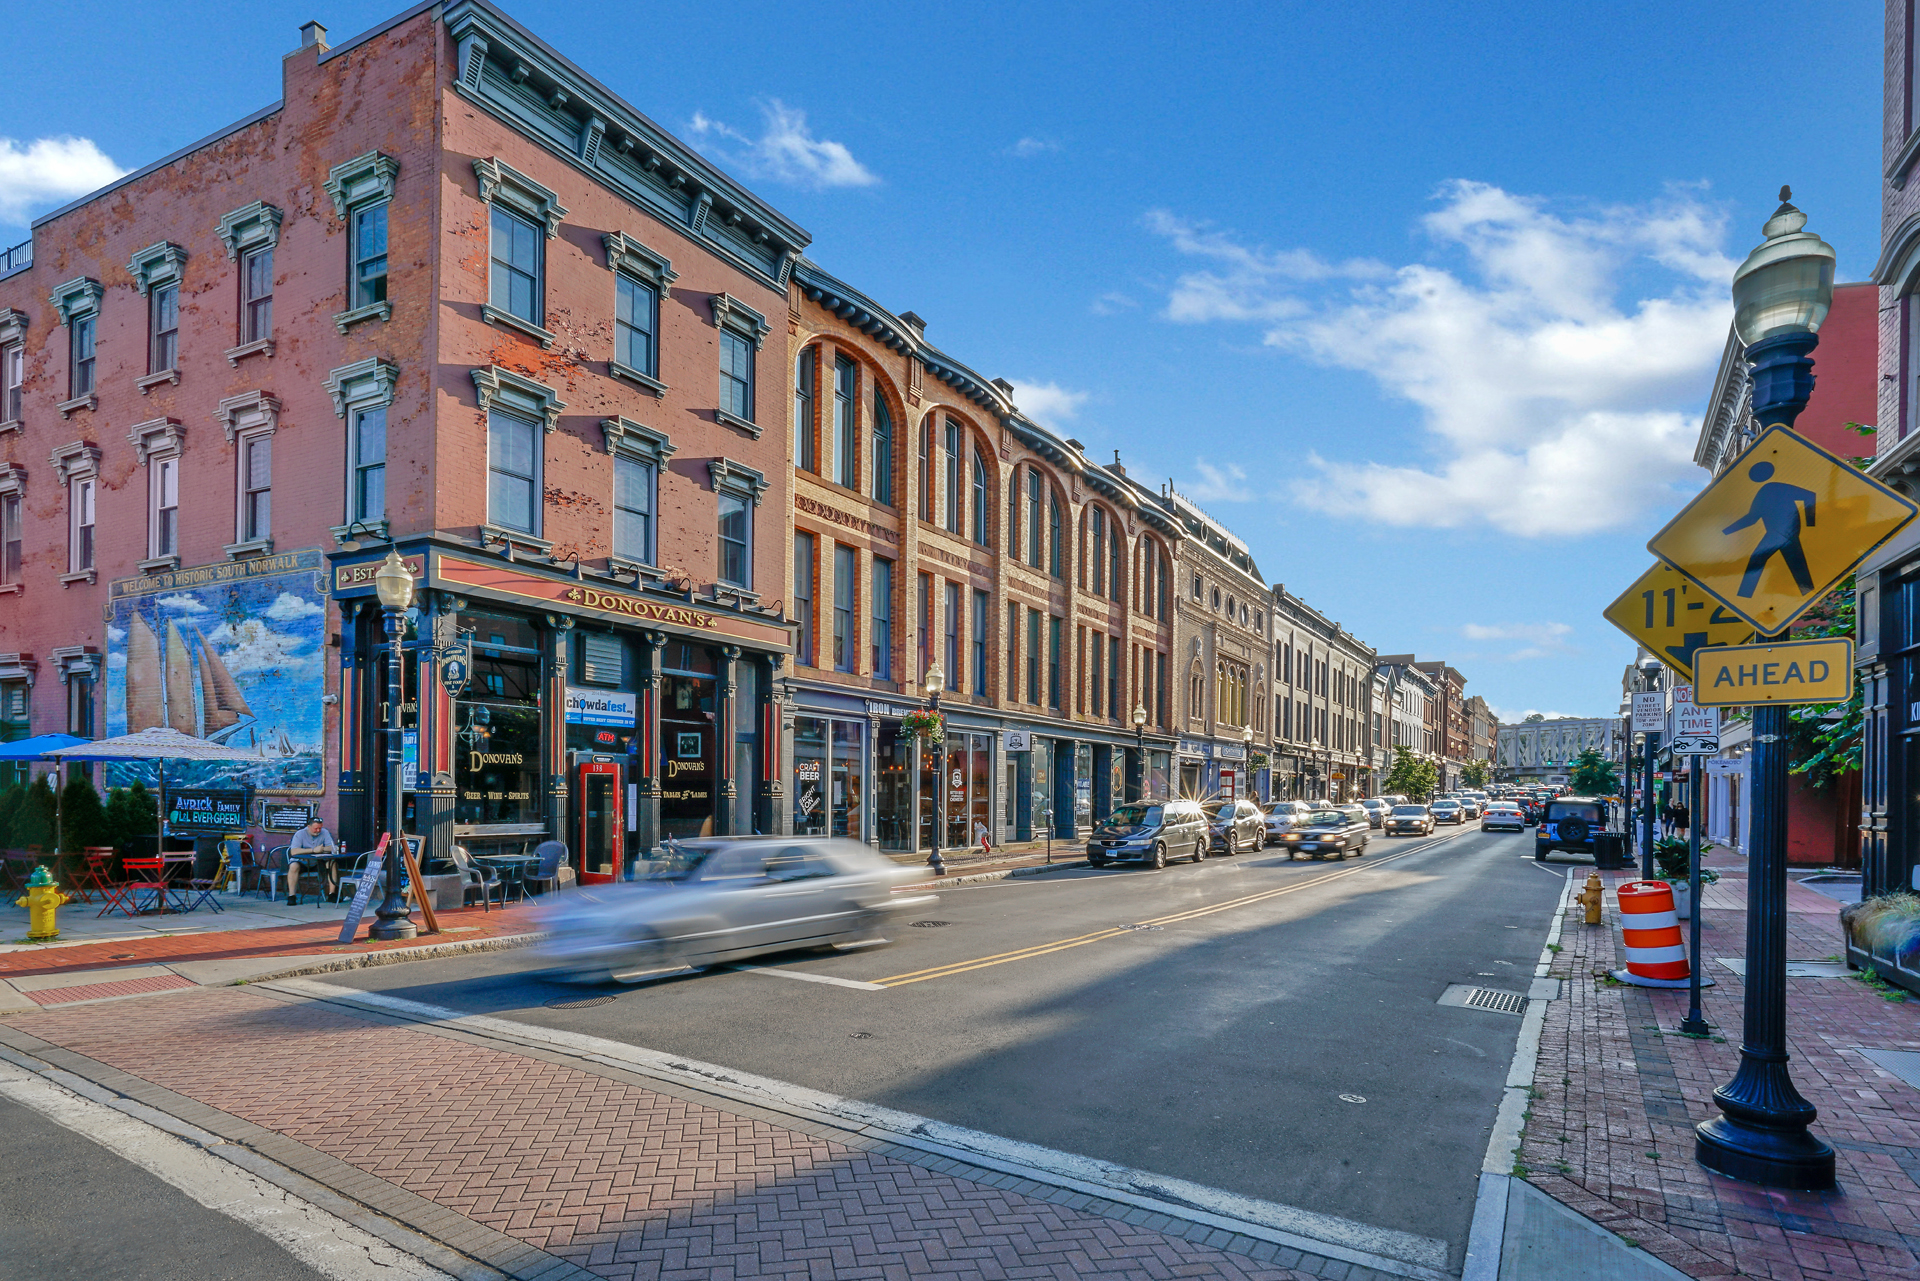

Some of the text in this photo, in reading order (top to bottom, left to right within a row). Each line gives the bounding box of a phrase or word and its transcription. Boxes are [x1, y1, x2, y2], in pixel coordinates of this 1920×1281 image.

[122, 555, 298, 593] WELCOME TO HISTORIC SOUTH NORWALK
[353, 567, 375, 582] EST.
[583, 589, 705, 627] DONOVAN'S
[1713, 660, 1829, 687] AHEAD
[1676, 687, 1687, 701] NO
[869, 702, 890, 715] IRON
[1681, 706, 1709, 716] ANY
[1679, 718, 1713, 729] TIME
[598, 732, 615, 743] ATM
[470, 751, 523, 772] DONOVAN'S
[800, 763, 820, 771] CRAFT
[668, 760, 705, 778] DONOVAN'S
[800, 772, 820, 780] BEER
[464, 791, 482, 799] BEER
[690, 791, 708, 799] LADIES
[217, 802, 240, 812] FAMILY
[804, 797, 813, 808] ON
